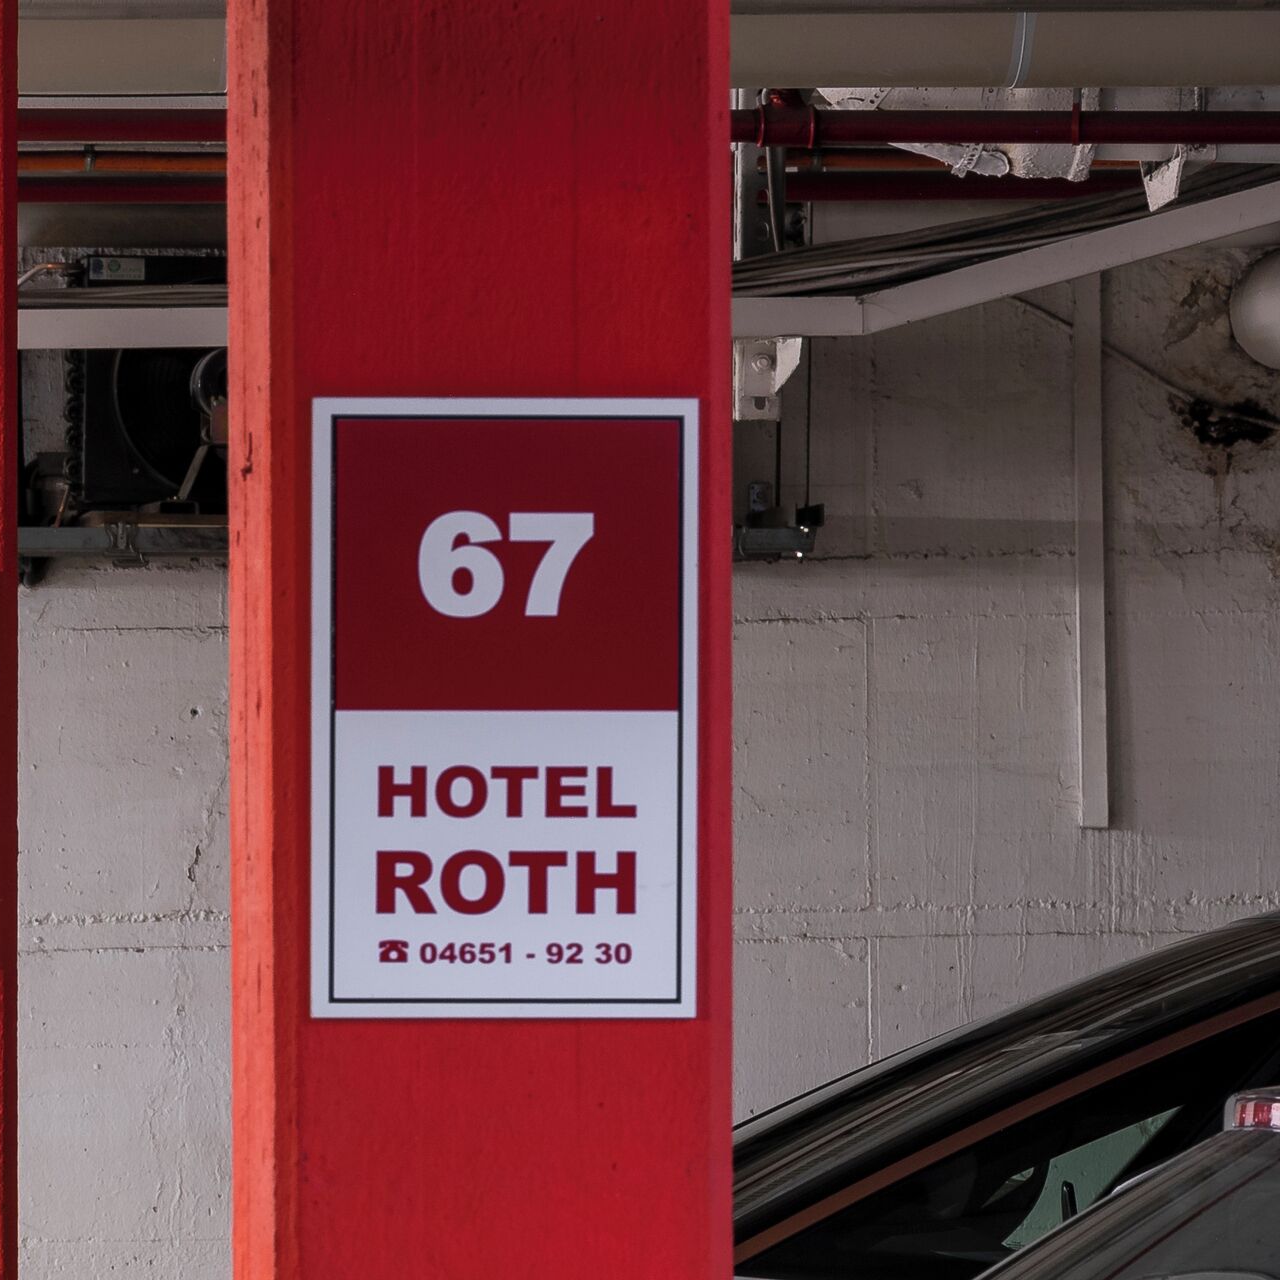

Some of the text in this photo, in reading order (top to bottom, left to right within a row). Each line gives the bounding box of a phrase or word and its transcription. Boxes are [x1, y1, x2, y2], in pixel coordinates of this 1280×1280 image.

[419, 511, 594, 617] 67
[378, 765, 636, 818] HOTEL
[376, 850, 636, 915] ROTH
[420, 943, 511, 963] 04651
[546, 943, 583, 963] 92
[596, 943, 632, 964] 30
